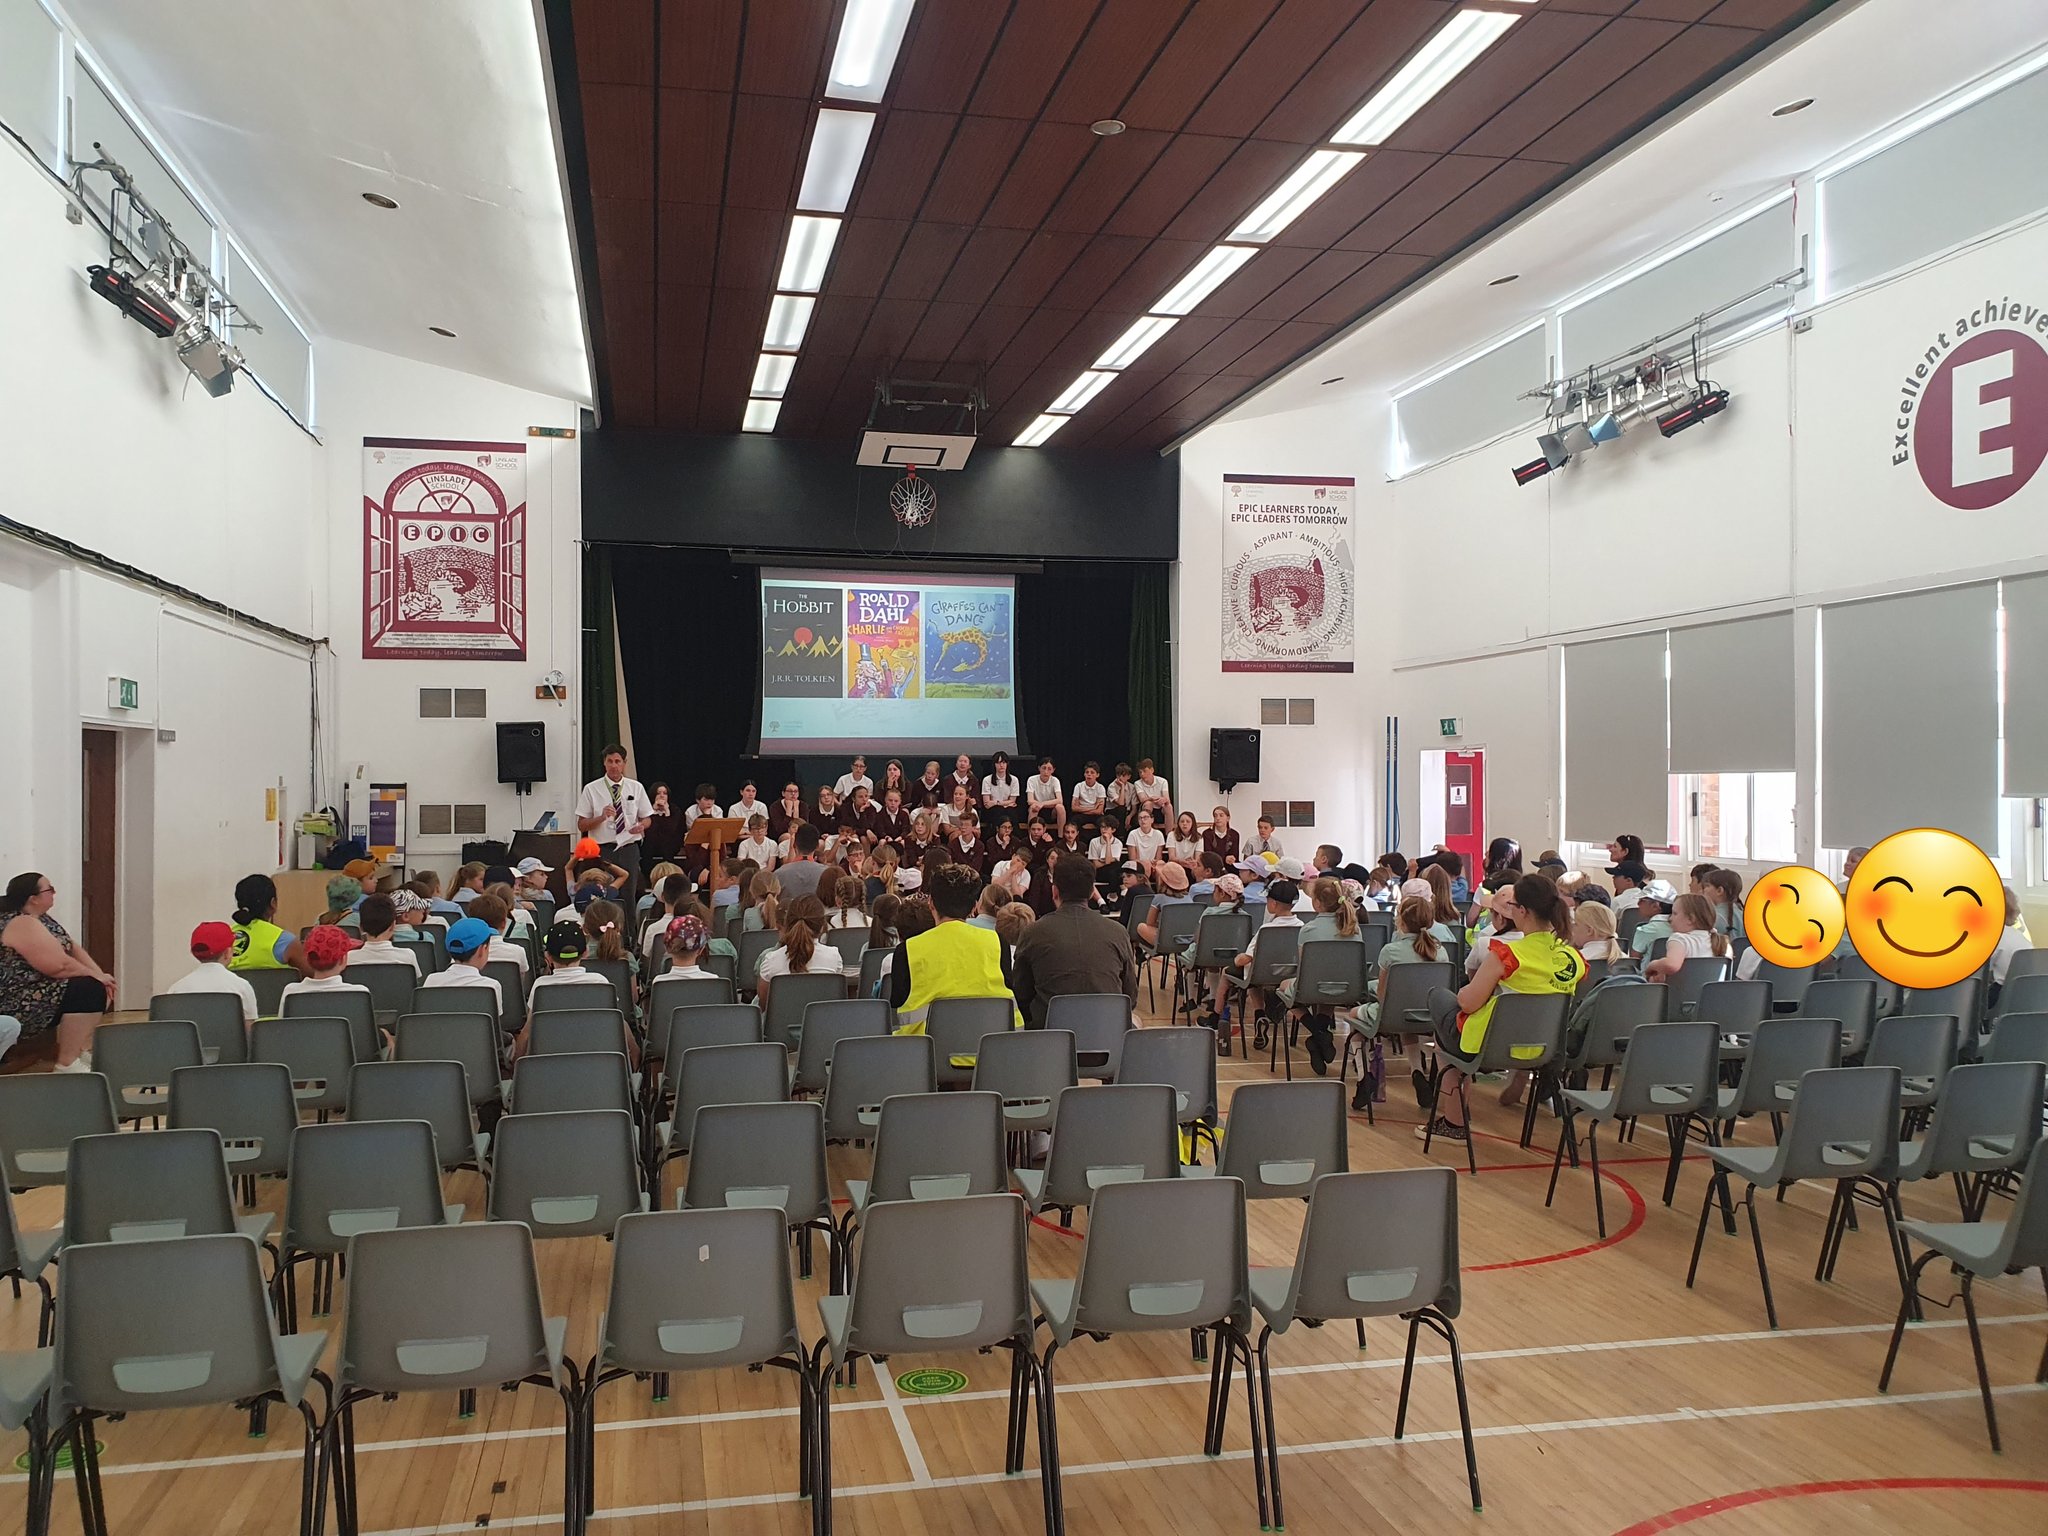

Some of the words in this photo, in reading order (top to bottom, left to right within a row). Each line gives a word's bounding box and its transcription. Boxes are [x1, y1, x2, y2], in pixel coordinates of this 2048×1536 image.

[1893, 332, 1951, 466] Excellent
[1956, 296, 2048, 340] achieve
[1952, 349, 2013, 488] E
[426, 475, 467, 485] LINSLADE
[431, 482, 461, 490] SCHOOL
[1239, 504, 1258, 513] EPIC
[1260, 505, 1305, 514] LEARNERS
[1307, 506, 1340, 516] TODAY,
[1231, 514, 1250, 523] EPIC
[1252, 514, 1290, 523] LEADERS
[1293, 515, 1348, 525] TOMORROW
[1253, 531, 1293, 550] ASPIRANT
[1300, 533, 1340, 567] AMBITIOUS
[1231, 552, 1251, 591] CURIOUS
[1338, 572, 1348, 595] HIGH
[773, 599, 834, 614] HOBBIT
[859, 592, 910, 608] ROALD
[931, 601, 975, 614] GIRAFFES
[859, 606, 909, 624] DAHL
[945, 614, 985, 626] DANCE
[1231, 598, 1252, 637] CREATIVE
[1323, 597, 1348, 642] ACHIEVING
[848, 624, 885, 635] CHARLIE
[1255, 638, 1320, 656] HARDWORKING
[794, 674, 836, 683] TOLKIEN
